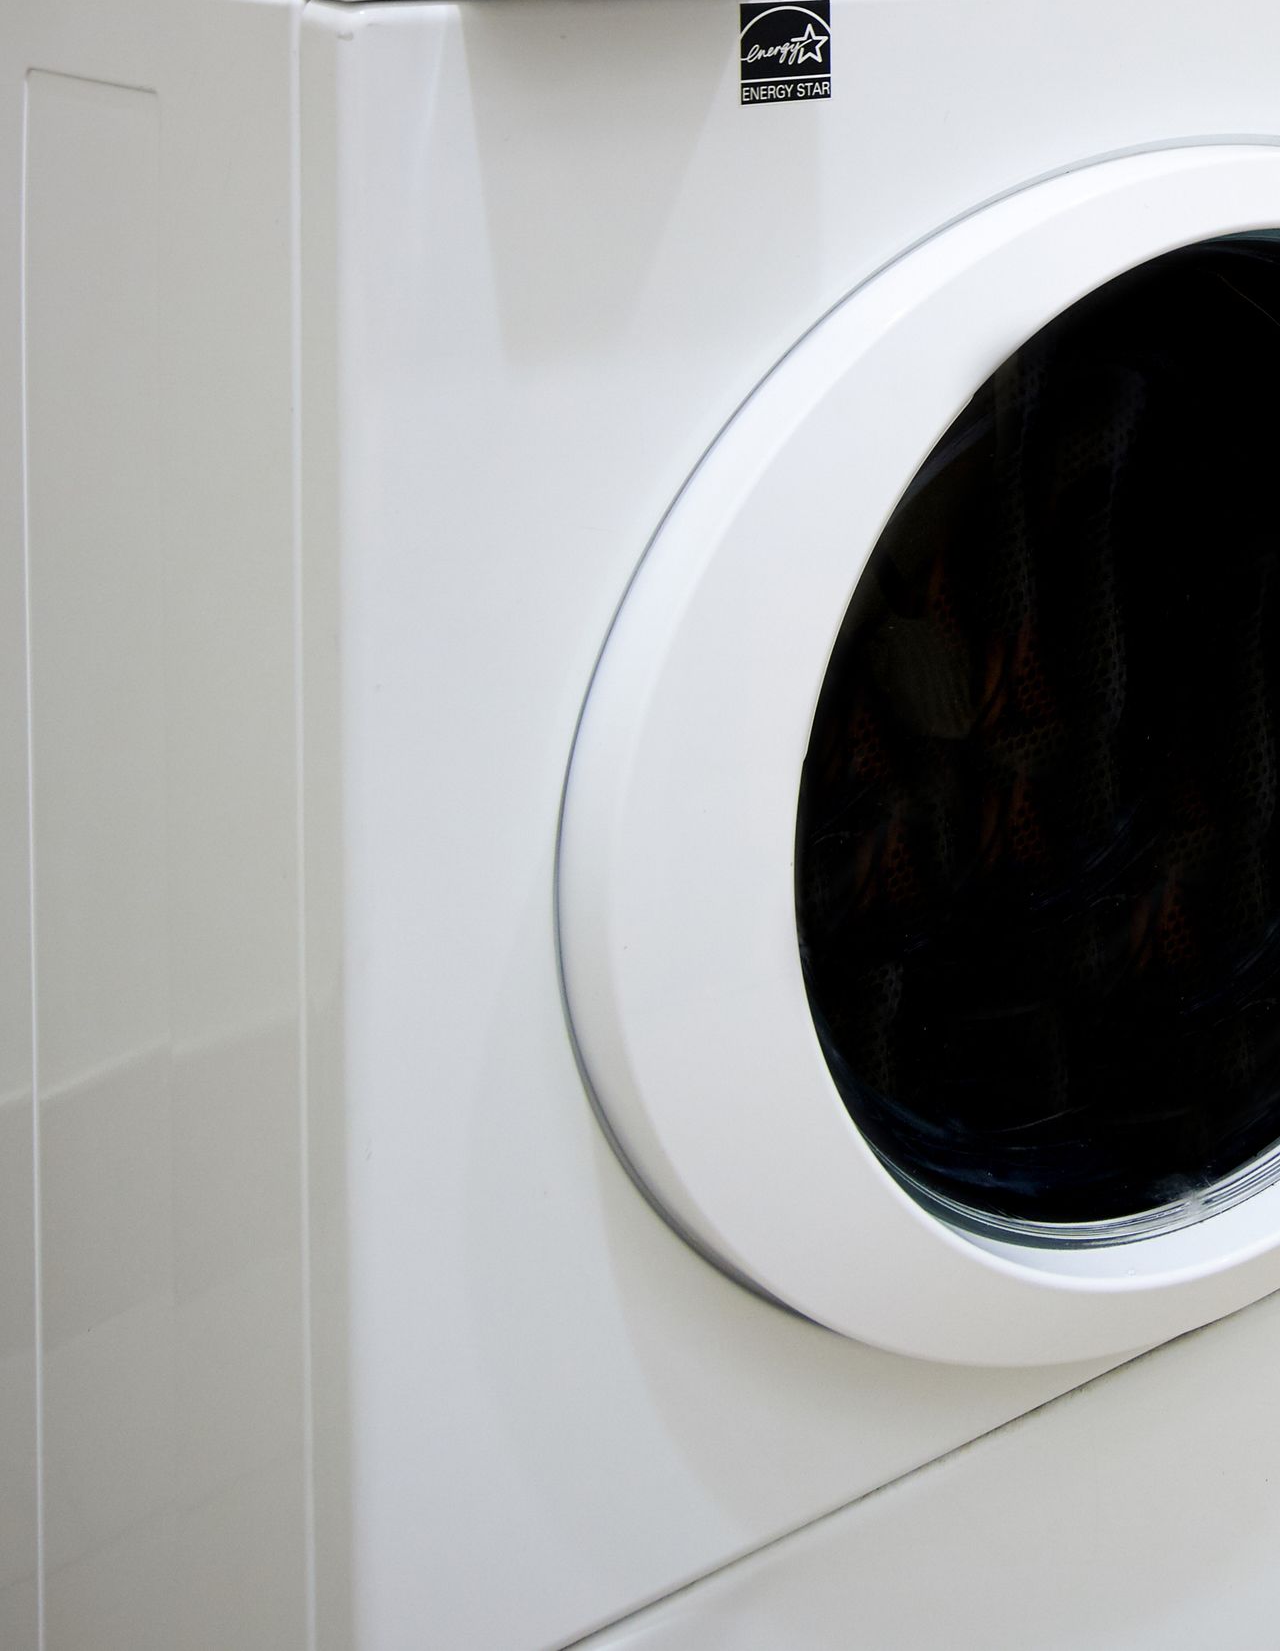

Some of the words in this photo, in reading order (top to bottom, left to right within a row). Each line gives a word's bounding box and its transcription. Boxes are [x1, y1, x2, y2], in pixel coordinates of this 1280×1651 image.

[744, 43, 803, 66] energy
[742, 83, 794, 102] ENERGY
[796, 82, 831, 98] STAR
